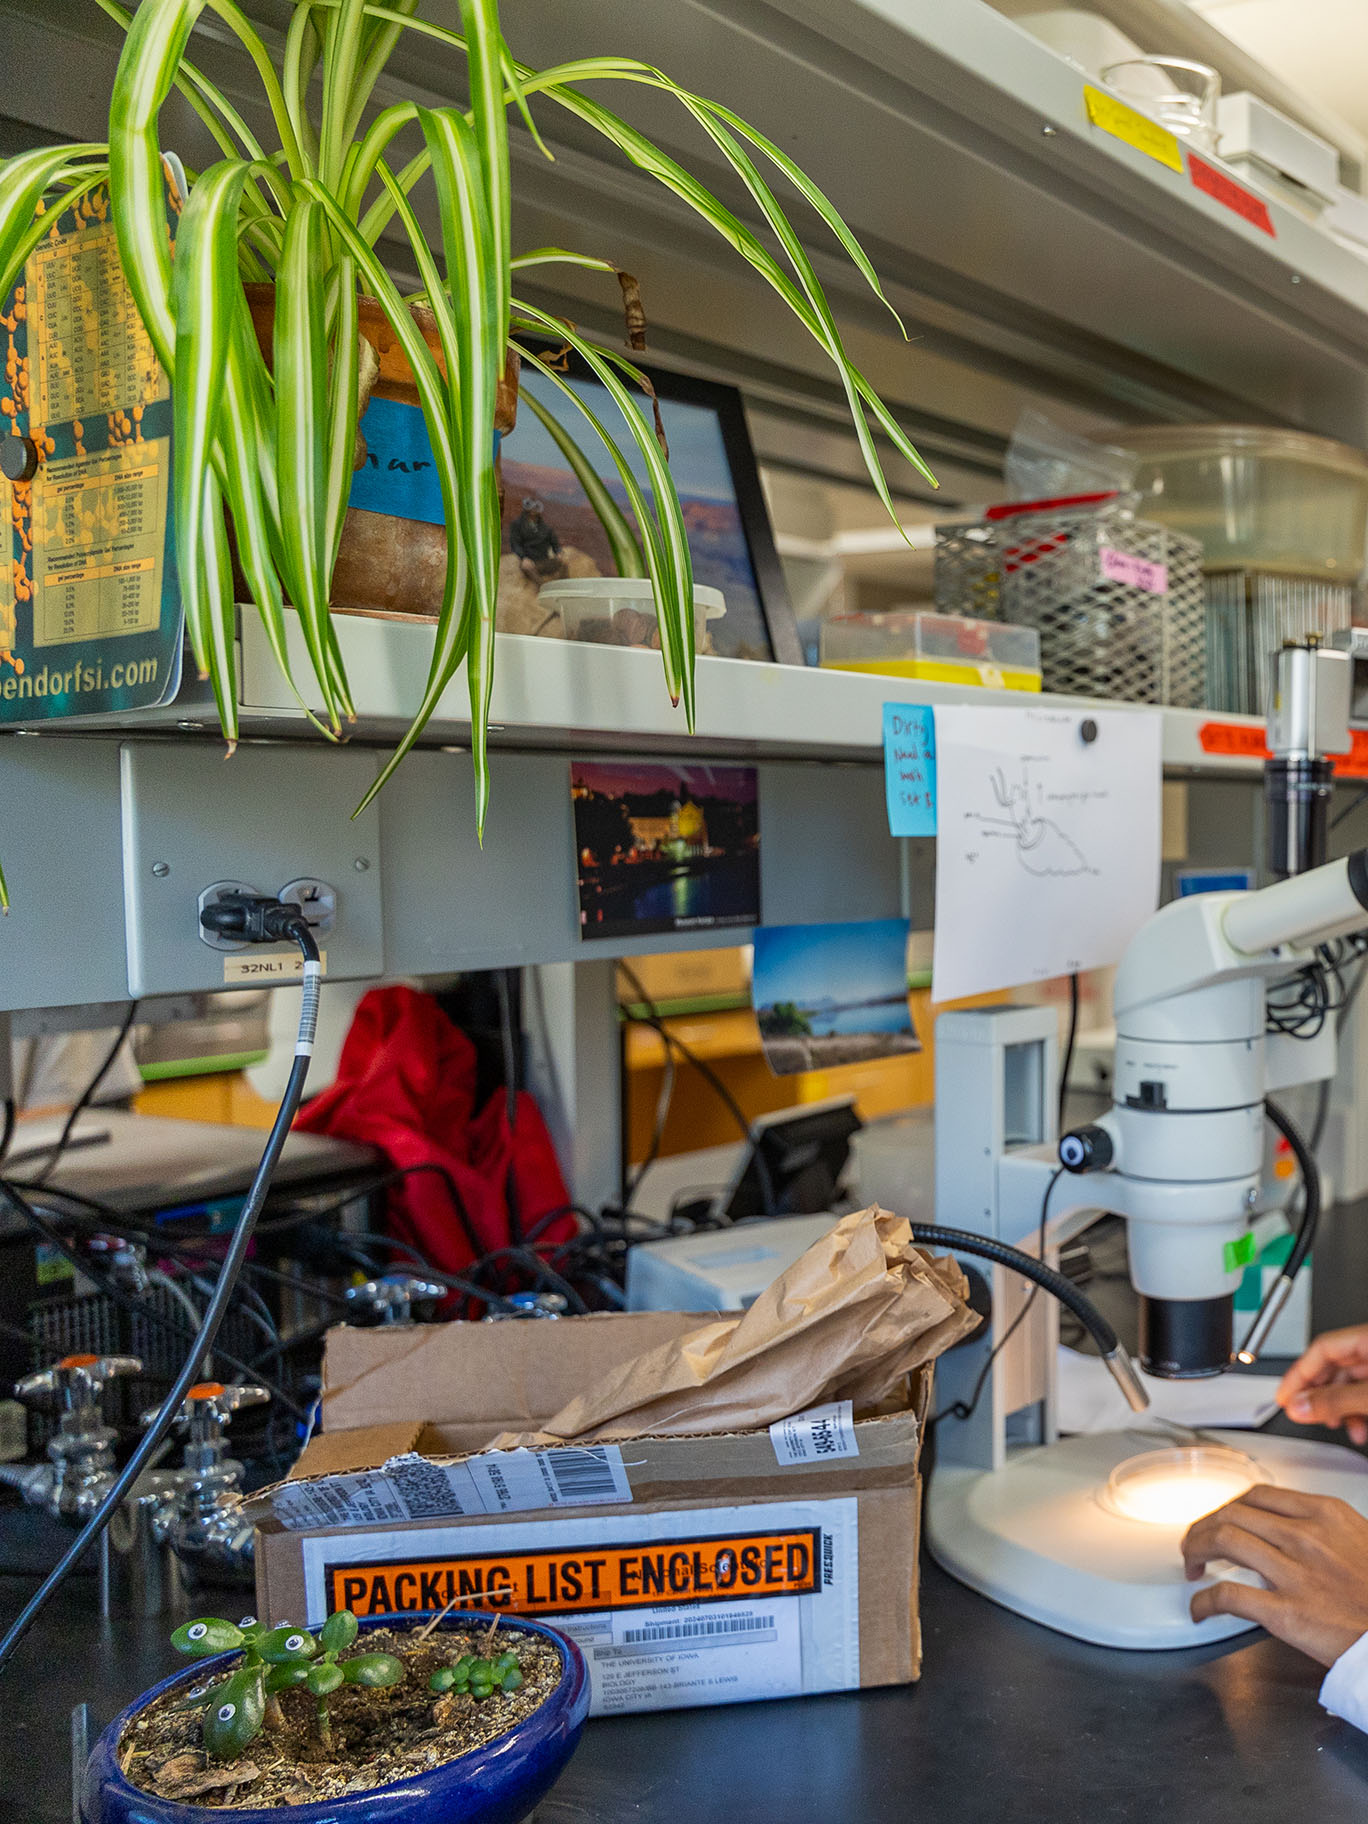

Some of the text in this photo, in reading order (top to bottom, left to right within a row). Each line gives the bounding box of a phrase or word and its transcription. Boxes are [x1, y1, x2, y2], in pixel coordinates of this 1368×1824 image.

[241, 961, 284, 975] 32NL1
[823, 1533, 834, 1586] PRESQUICK
[344, 1566, 513, 1614] PACKING
[526, 1558, 606, 1604] LIST
[620, 1541, 809, 1597] ENCLOSED
[644, 1617, 680, 1628] Shipment
[601, 1651, 700, 1668] THE UNIVERSITY OF IOWA
[623, 1668, 669, 1679] JEFFERSON
[601, 1679, 635, 1689] BIOLOGY
